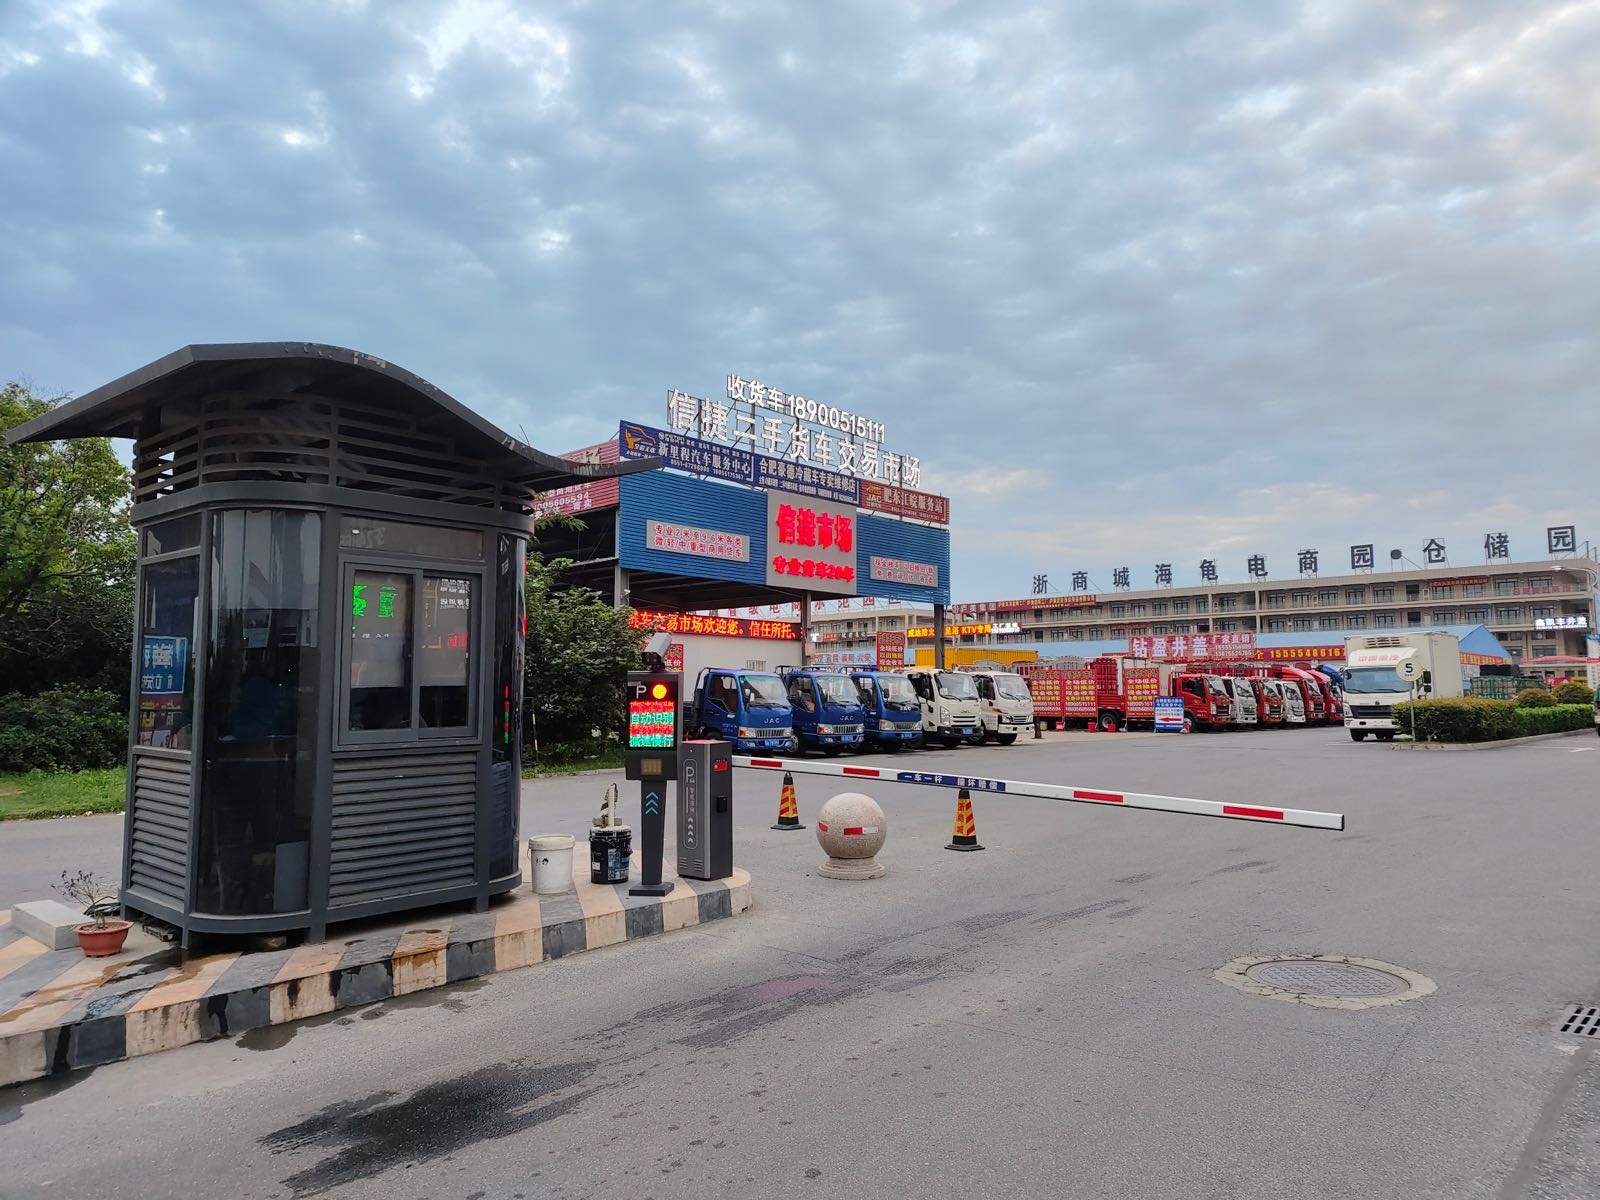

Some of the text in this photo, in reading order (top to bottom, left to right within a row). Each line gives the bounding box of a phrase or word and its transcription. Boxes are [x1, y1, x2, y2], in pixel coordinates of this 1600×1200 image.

[669, 389, 920, 488] 信捷二手货车交易市场
[658, 441, 751, 475] 新里程汽车服务中心
[866, 493, 882, 505] JAC
[776, 503, 853, 553] 信捷市场
[1212, 633, 1251, 644] 厂家直销
[1132, 637, 1208, 658] 钻盈井盖
[1405, 663, 1414, 674] 5
[636, 684, 647, 699] P
[630, 712, 674, 724] 自动识别
[904, 773, 943, 784] 一车一杆
